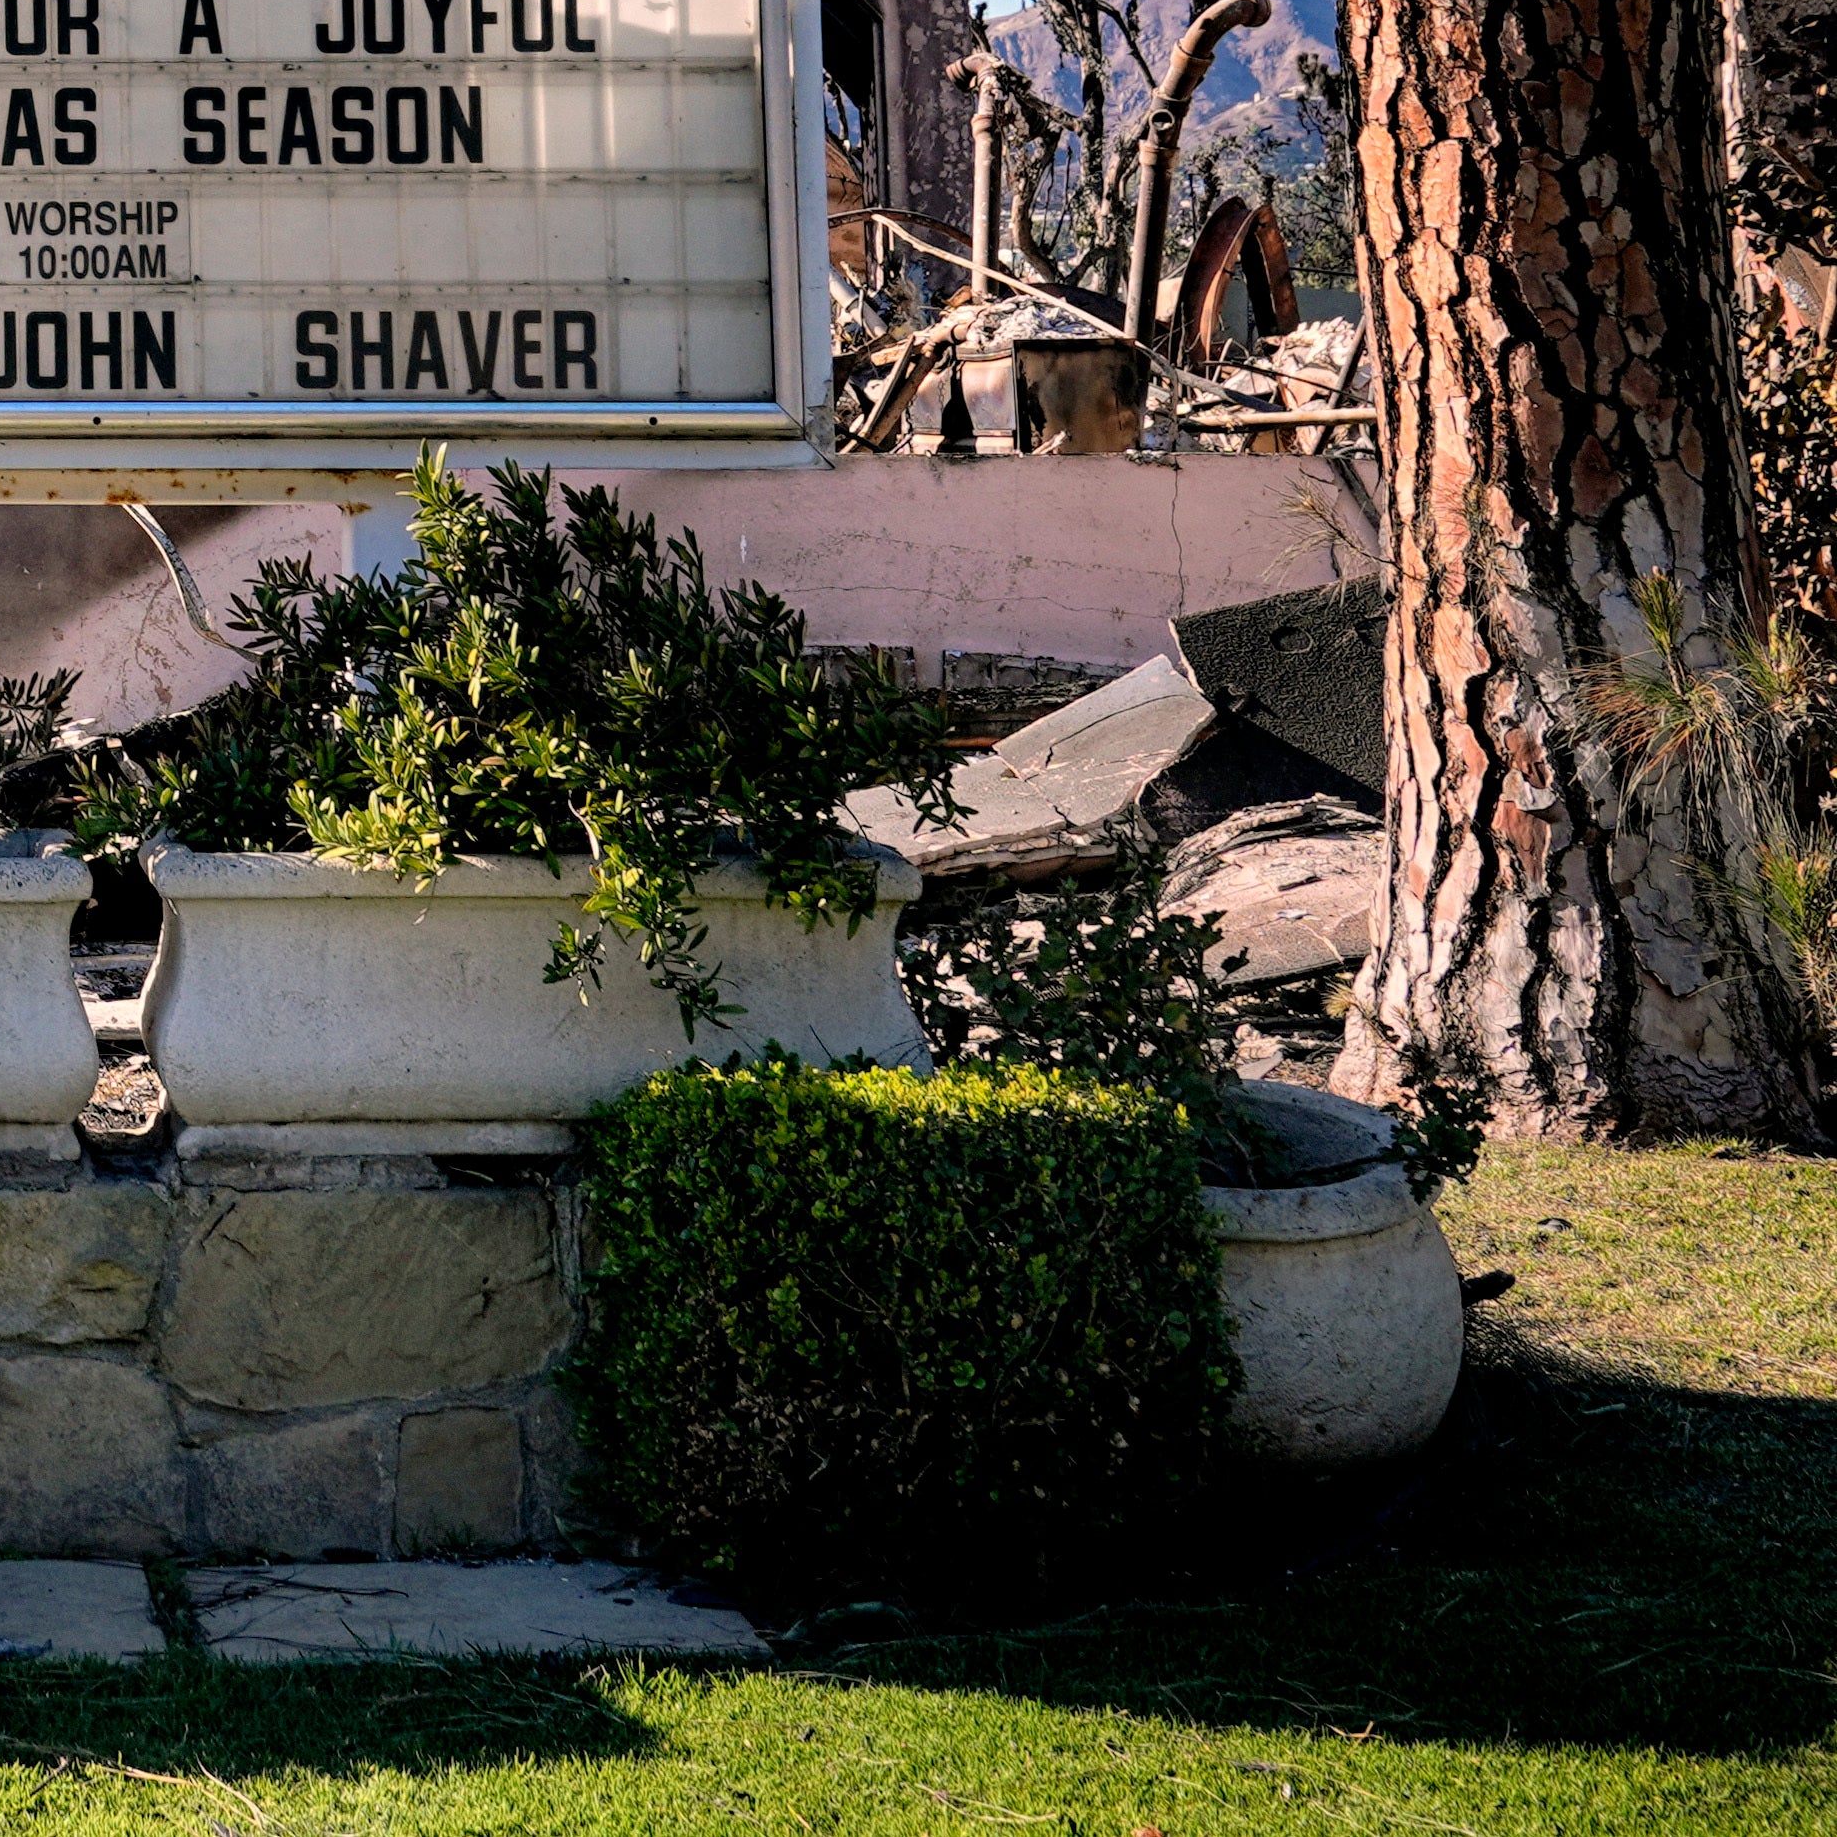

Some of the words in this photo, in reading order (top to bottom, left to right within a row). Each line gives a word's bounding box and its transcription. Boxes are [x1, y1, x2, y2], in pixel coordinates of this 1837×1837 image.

[183, 85, 484, 165] SEASON
[4, 200, 179, 237] WORSHIP
[18, 244, 167, 280] 10:00AM
[296, 309, 598, 390] SHAVER
